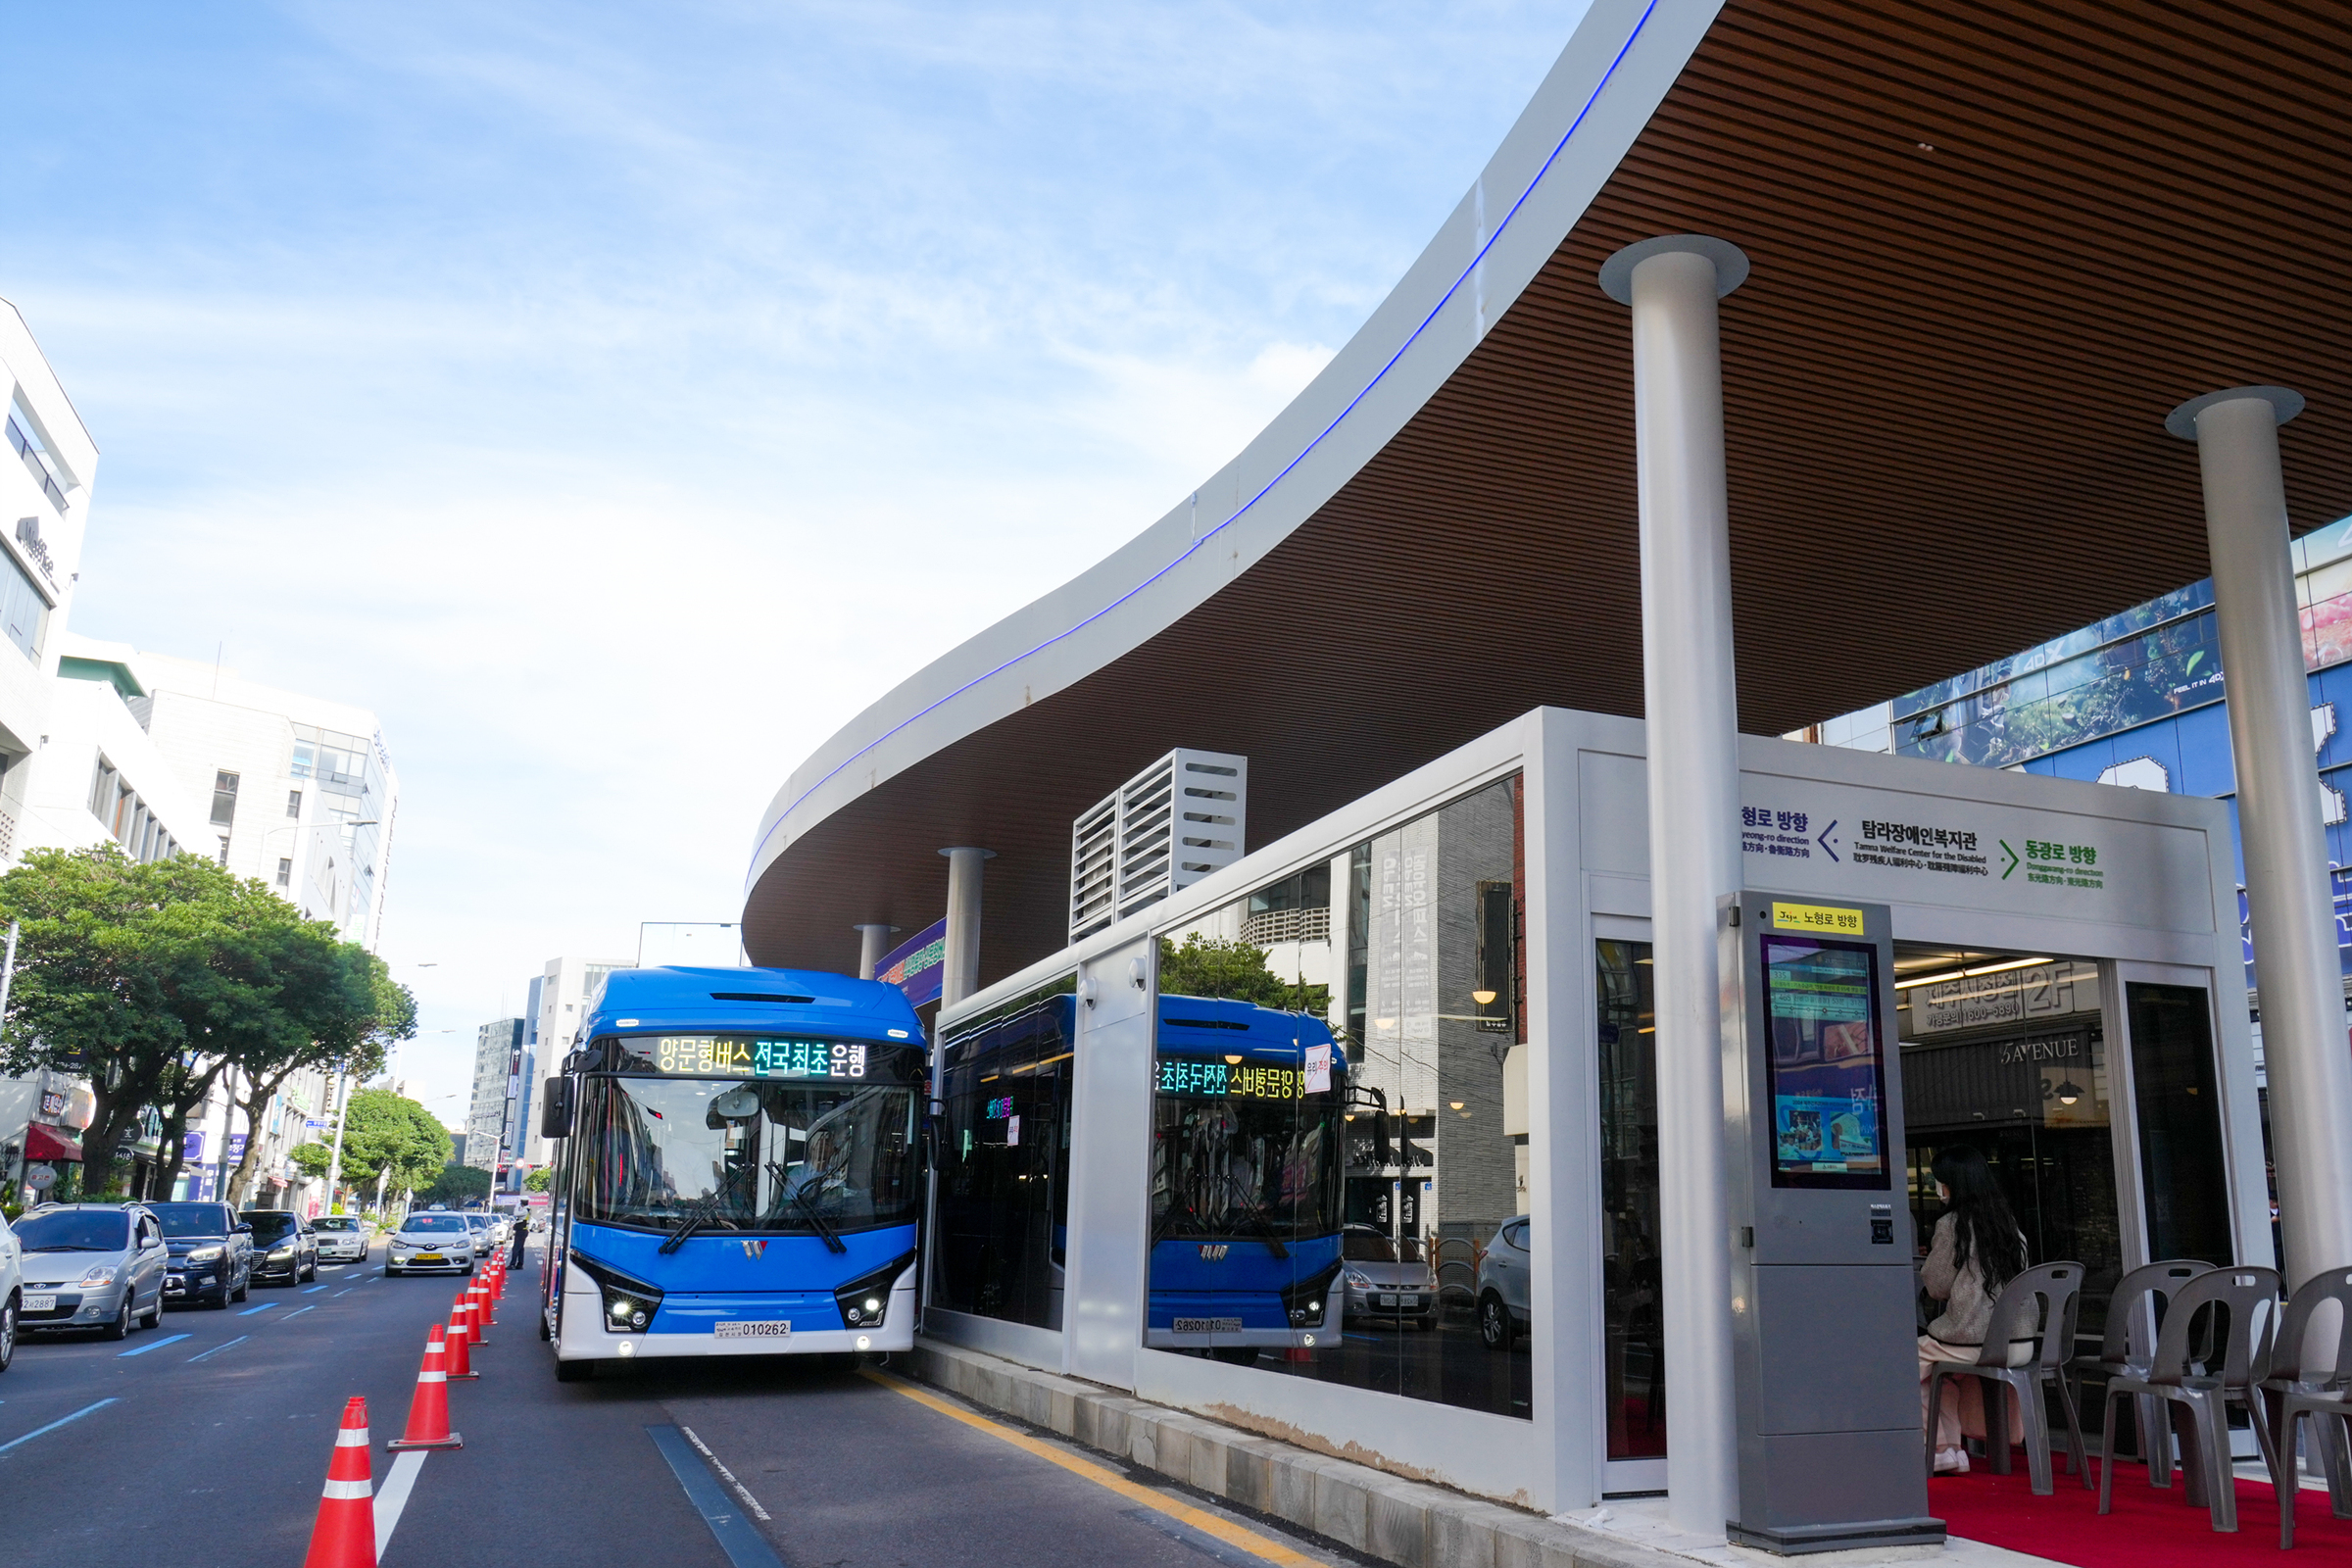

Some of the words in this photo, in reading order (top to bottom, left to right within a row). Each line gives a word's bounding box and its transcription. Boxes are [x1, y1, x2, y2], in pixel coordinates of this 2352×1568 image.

[2023, 640, 2065, 672] 4DX
[2174, 685, 2191, 694] FEEL
[1777, 811, 1808, 833] 방향
[1776, 834, 1810, 846] direction
[1862, 820, 1978, 851] 탐라장애인복지관
[1854, 842, 1879, 852] Tamna
[1880, 845, 1907, 856] Welfare
[1907, 848, 1931, 858] Center
[1932, 851, 1942, 859] for
[1943, 853, 1956, 861] the
[1957, 854, 1986, 864] Disabled
[2025, 839, 2066, 860] 동광로
[2069, 845, 2096, 865] 방향
[2075, 867, 2104, 877] direction
[1804, 911, 1834, 926] 노형로
[1838, 914, 1858, 928] 방향
[2027, 962, 2074, 1010] 2F
[1927, 1010, 1959, 1027] 가맹문의
[661, 1038, 751, 1073] 양문형버스
[755, 1041, 828, 1075] 전국최초
[830, 1044, 866, 1077] 운행
[743, 1323, 787, 1335] 010262
